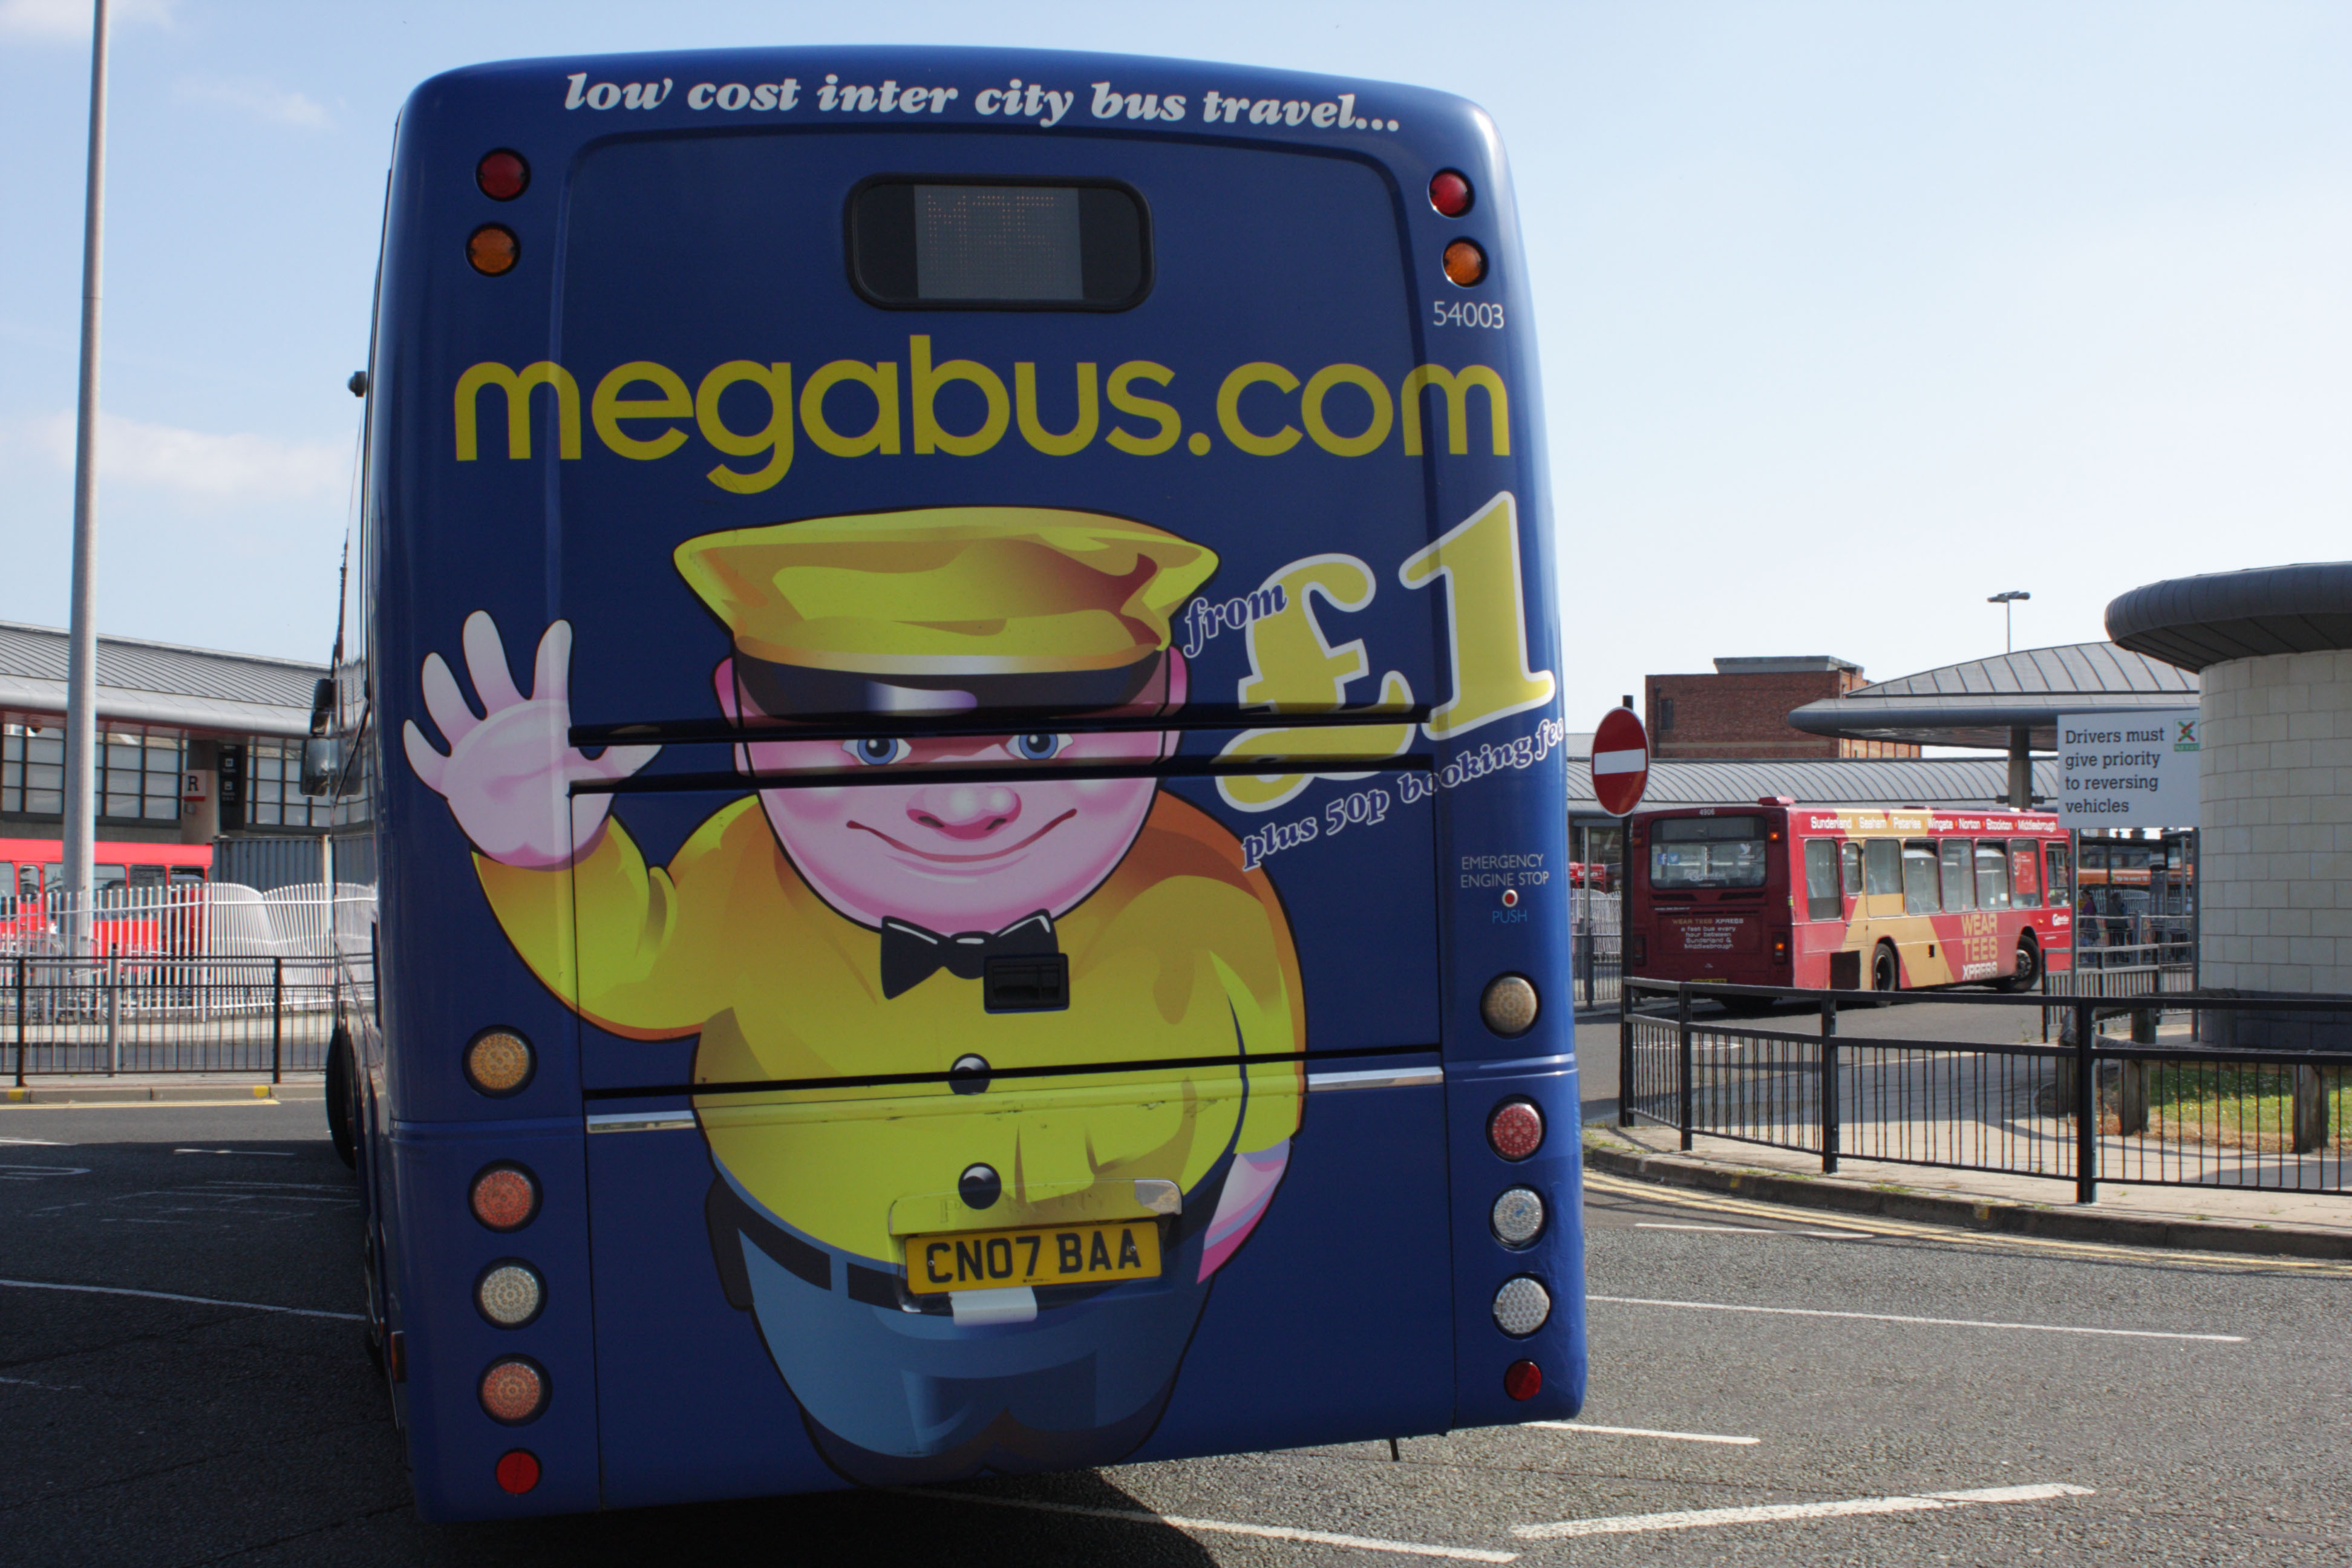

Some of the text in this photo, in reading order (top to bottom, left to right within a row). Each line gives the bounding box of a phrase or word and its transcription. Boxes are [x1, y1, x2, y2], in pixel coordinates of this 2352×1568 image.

[564, 72, 1399, 132] low cost inter city bus travel...
[1433, 301, 1504, 329] 54003
[455, 335, 1511, 494] megabus.com
[1183, 584, 1287, 657] from
[1215, 491, 1555, 812] £1
[2065, 727, 2164, 744] Drivers must
[2065, 751, 2161, 770] give priority
[188, 776, 198, 791] R
[2065, 774, 2159, 792] to reversing
[1241, 717, 1564, 871] plus 50p booking fee
[2065, 798, 2129, 812] vehicles
[1811, 816, 1852, 829] Sunderland
[1858, 817, 1887, 829] Seaham
[1927, 817, 1953, 832] Wingate
[1958, 818, 1981, 829] Norton
[1986, 818, 2013, 831] Stockton
[1462, 854, 1543, 870] EMERGENCY
[1460, 871, 1549, 888] ENGINE STOP
[1492, 910, 1527, 924] PUSH
[1961, 913, 1997, 936] WEAR
[1962, 936, 1998, 962] TEES
[1962, 961, 1998, 981] XPRESS
[926, 1229, 1142, 1284] CN07 BAA
